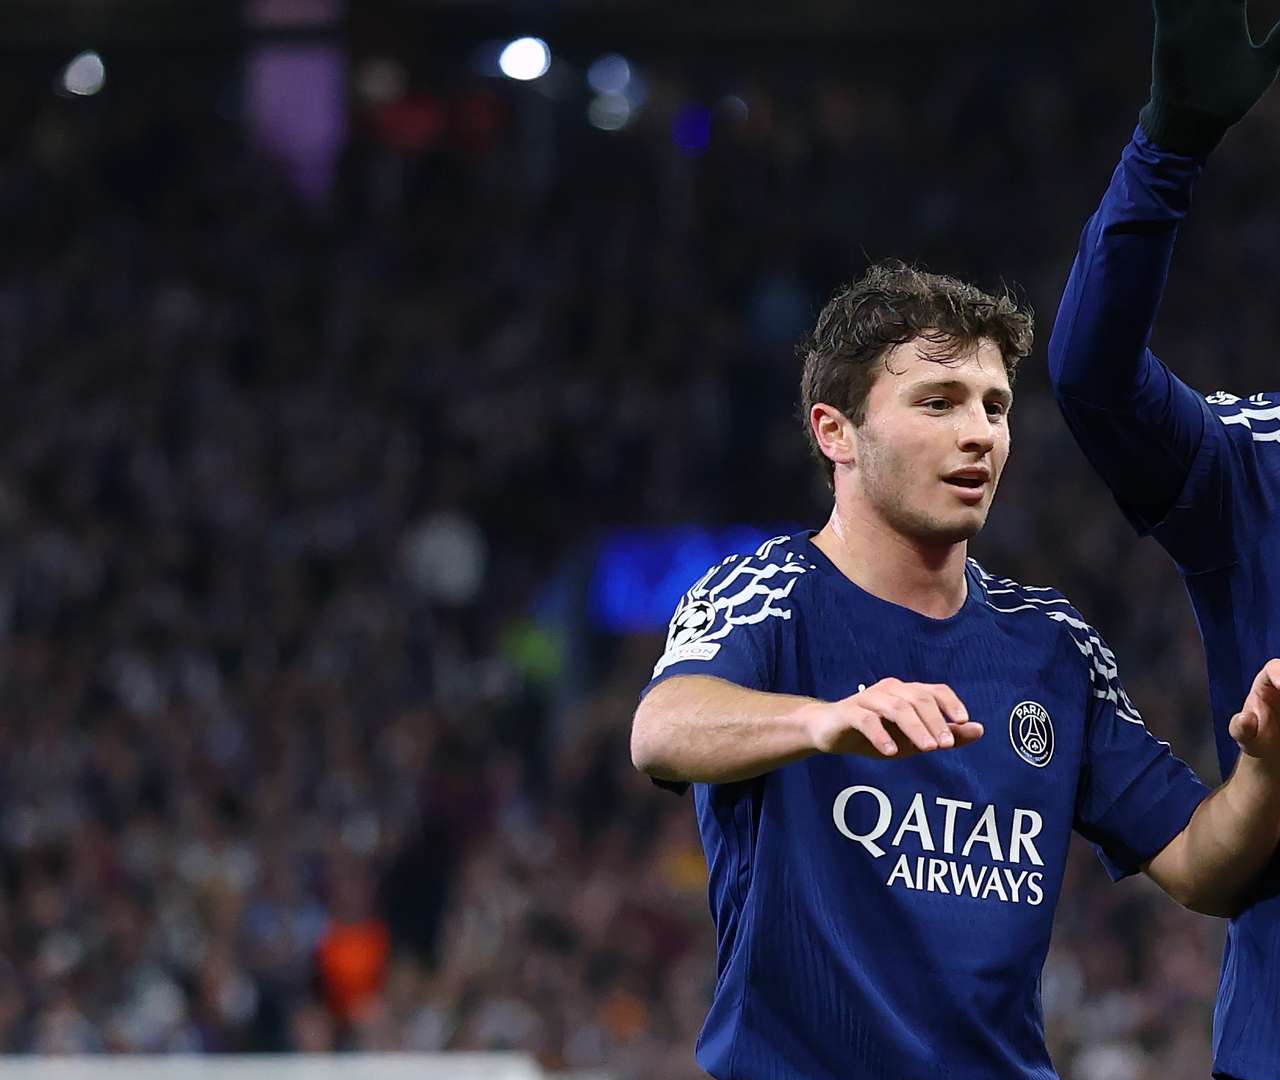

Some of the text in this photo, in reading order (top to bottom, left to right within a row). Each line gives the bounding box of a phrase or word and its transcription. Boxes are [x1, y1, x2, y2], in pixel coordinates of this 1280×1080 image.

[1016, 704, 1047, 722] PARIS
[832, 785, 1045, 866] QATAR
[886, 854, 1044, 906] AIRWAYS
